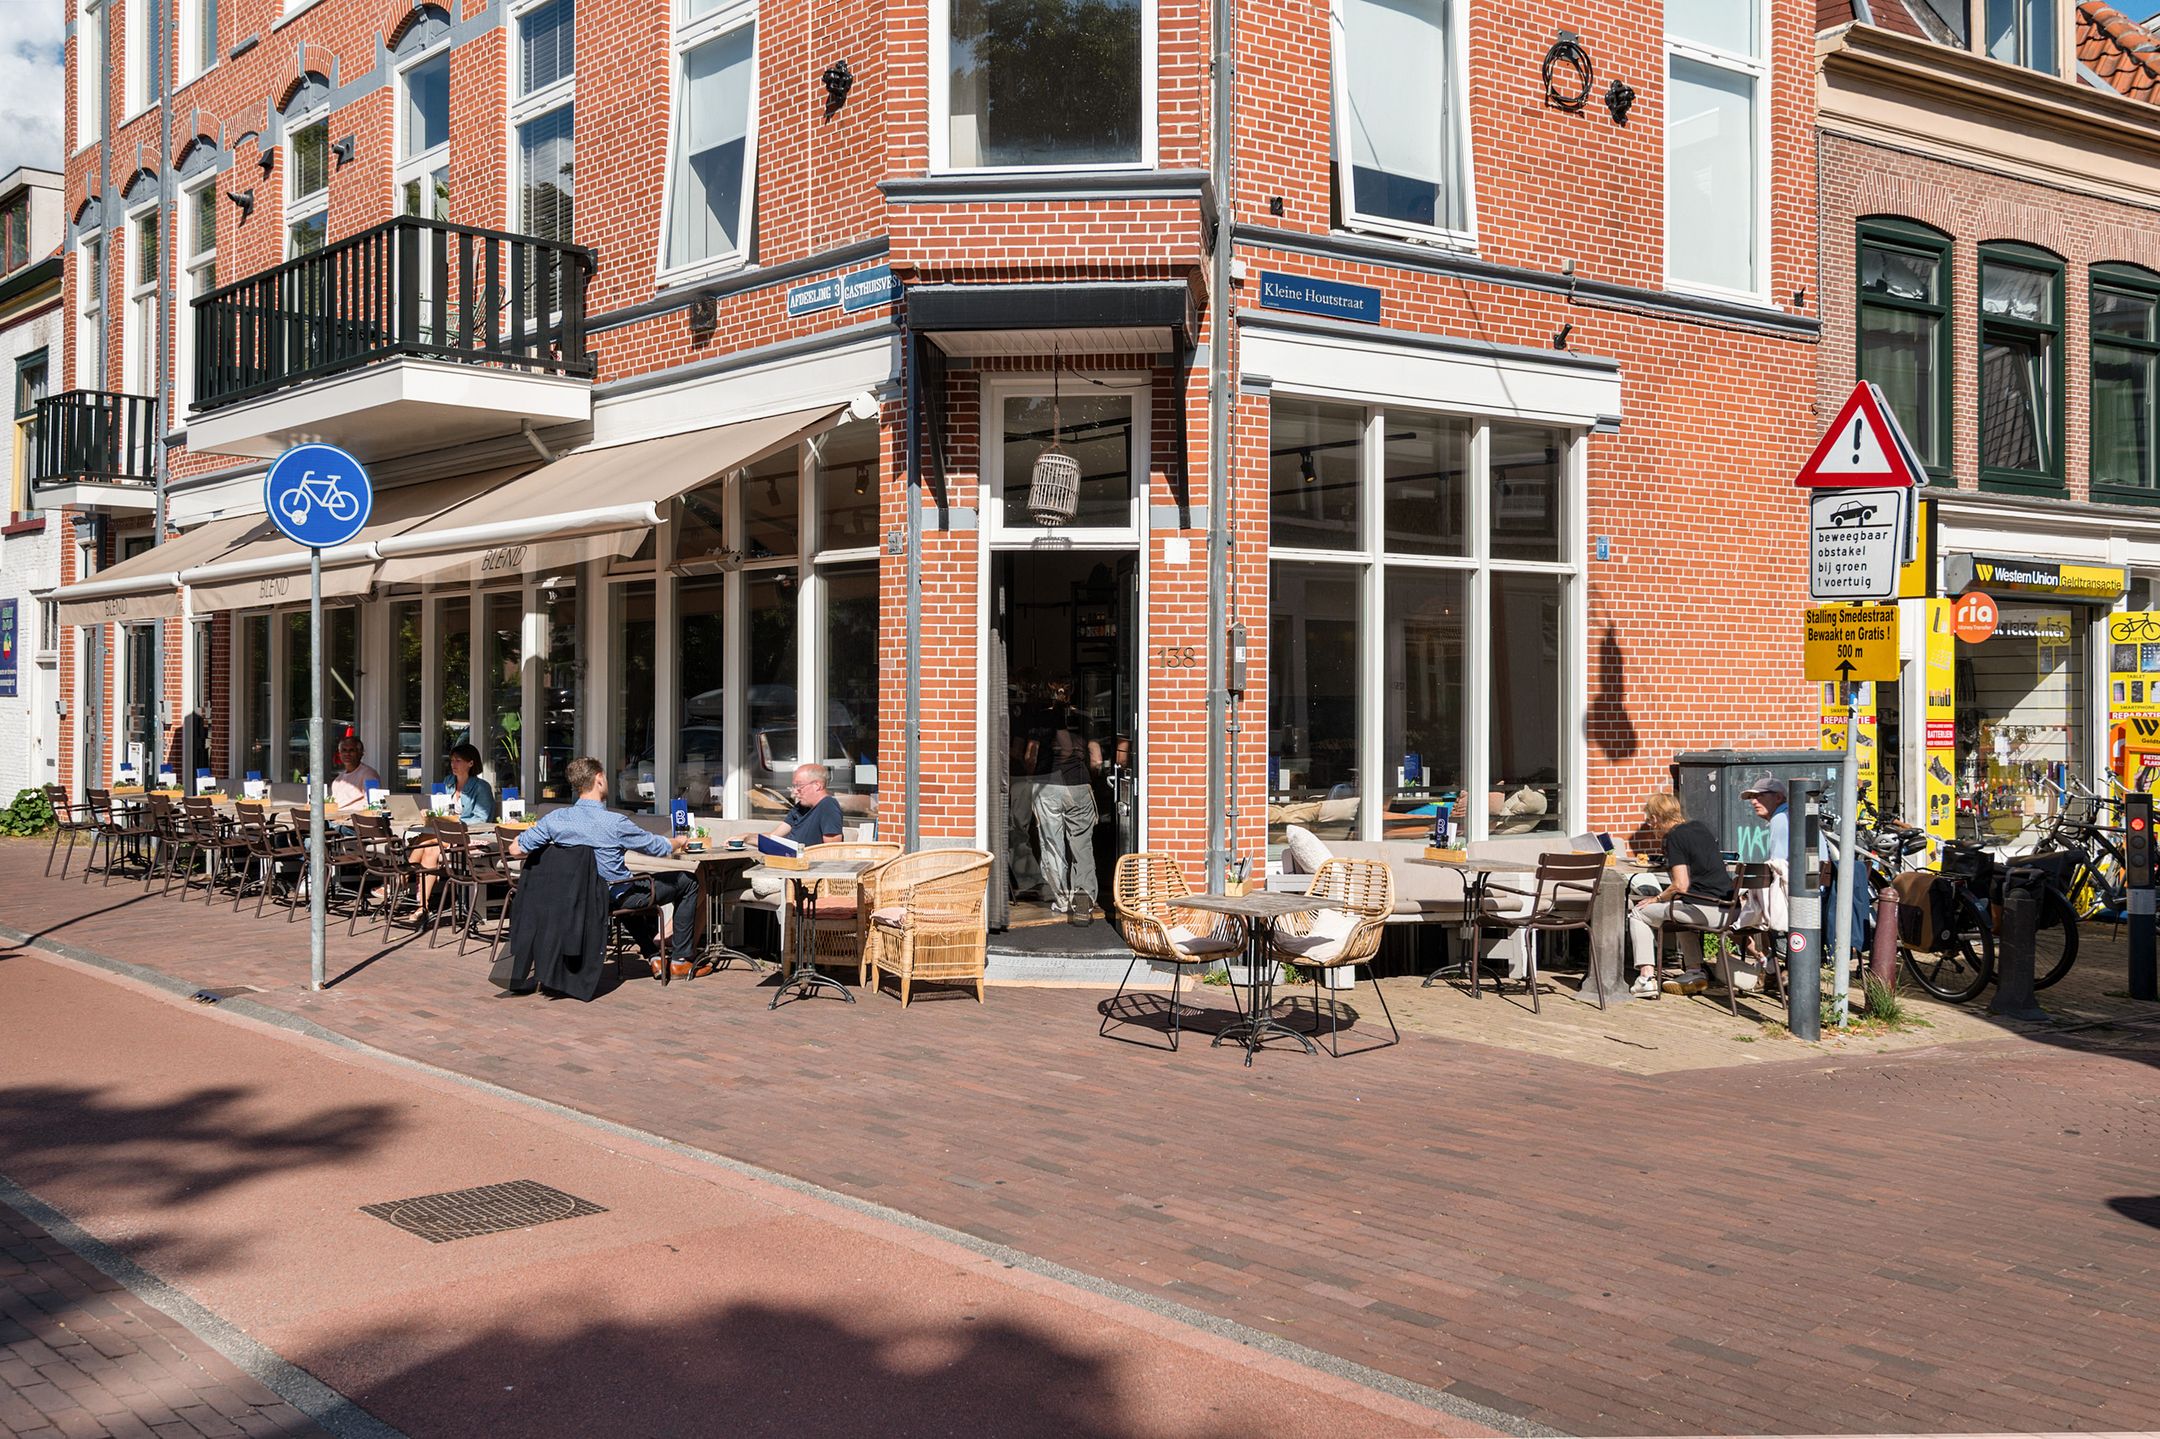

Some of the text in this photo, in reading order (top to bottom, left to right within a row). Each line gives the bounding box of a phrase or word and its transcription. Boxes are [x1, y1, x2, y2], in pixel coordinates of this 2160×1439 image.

[790, 284, 840, 308] AFDEELING 3
[1264, 282, 1364, 310] Kleine Houtstraat
[1818, 531, 1888, 543] beweegbaar
[481, 545, 528, 571] BLEND
[1818, 545, 1866, 557] obstakel
[1818, 562, 1867, 575] bij groen
[1995, 567, 2032, 583] Western
[2032, 570, 2059, 586] Union
[260, 576, 289, 599] BLEND
[1818, 576, 1871, 589] 1 voertuig
[2060, 576, 2122, 591] Geldtransactie
[105, 597, 128, 617] BLEND
[1957, 597, 1993, 623] ria
[1806, 608, 1894, 627] Stalling Smedestraat
[1807, 628, 1843, 641] Bewaakt
[1845, 630, 1856, 641] en
[1858, 626, 1885, 640] Gratis
[1157, 647, 1196, 669] 138
[1837, 644, 1863, 658] 500 m
[1823, 716, 1871, 724] REPARTIE
